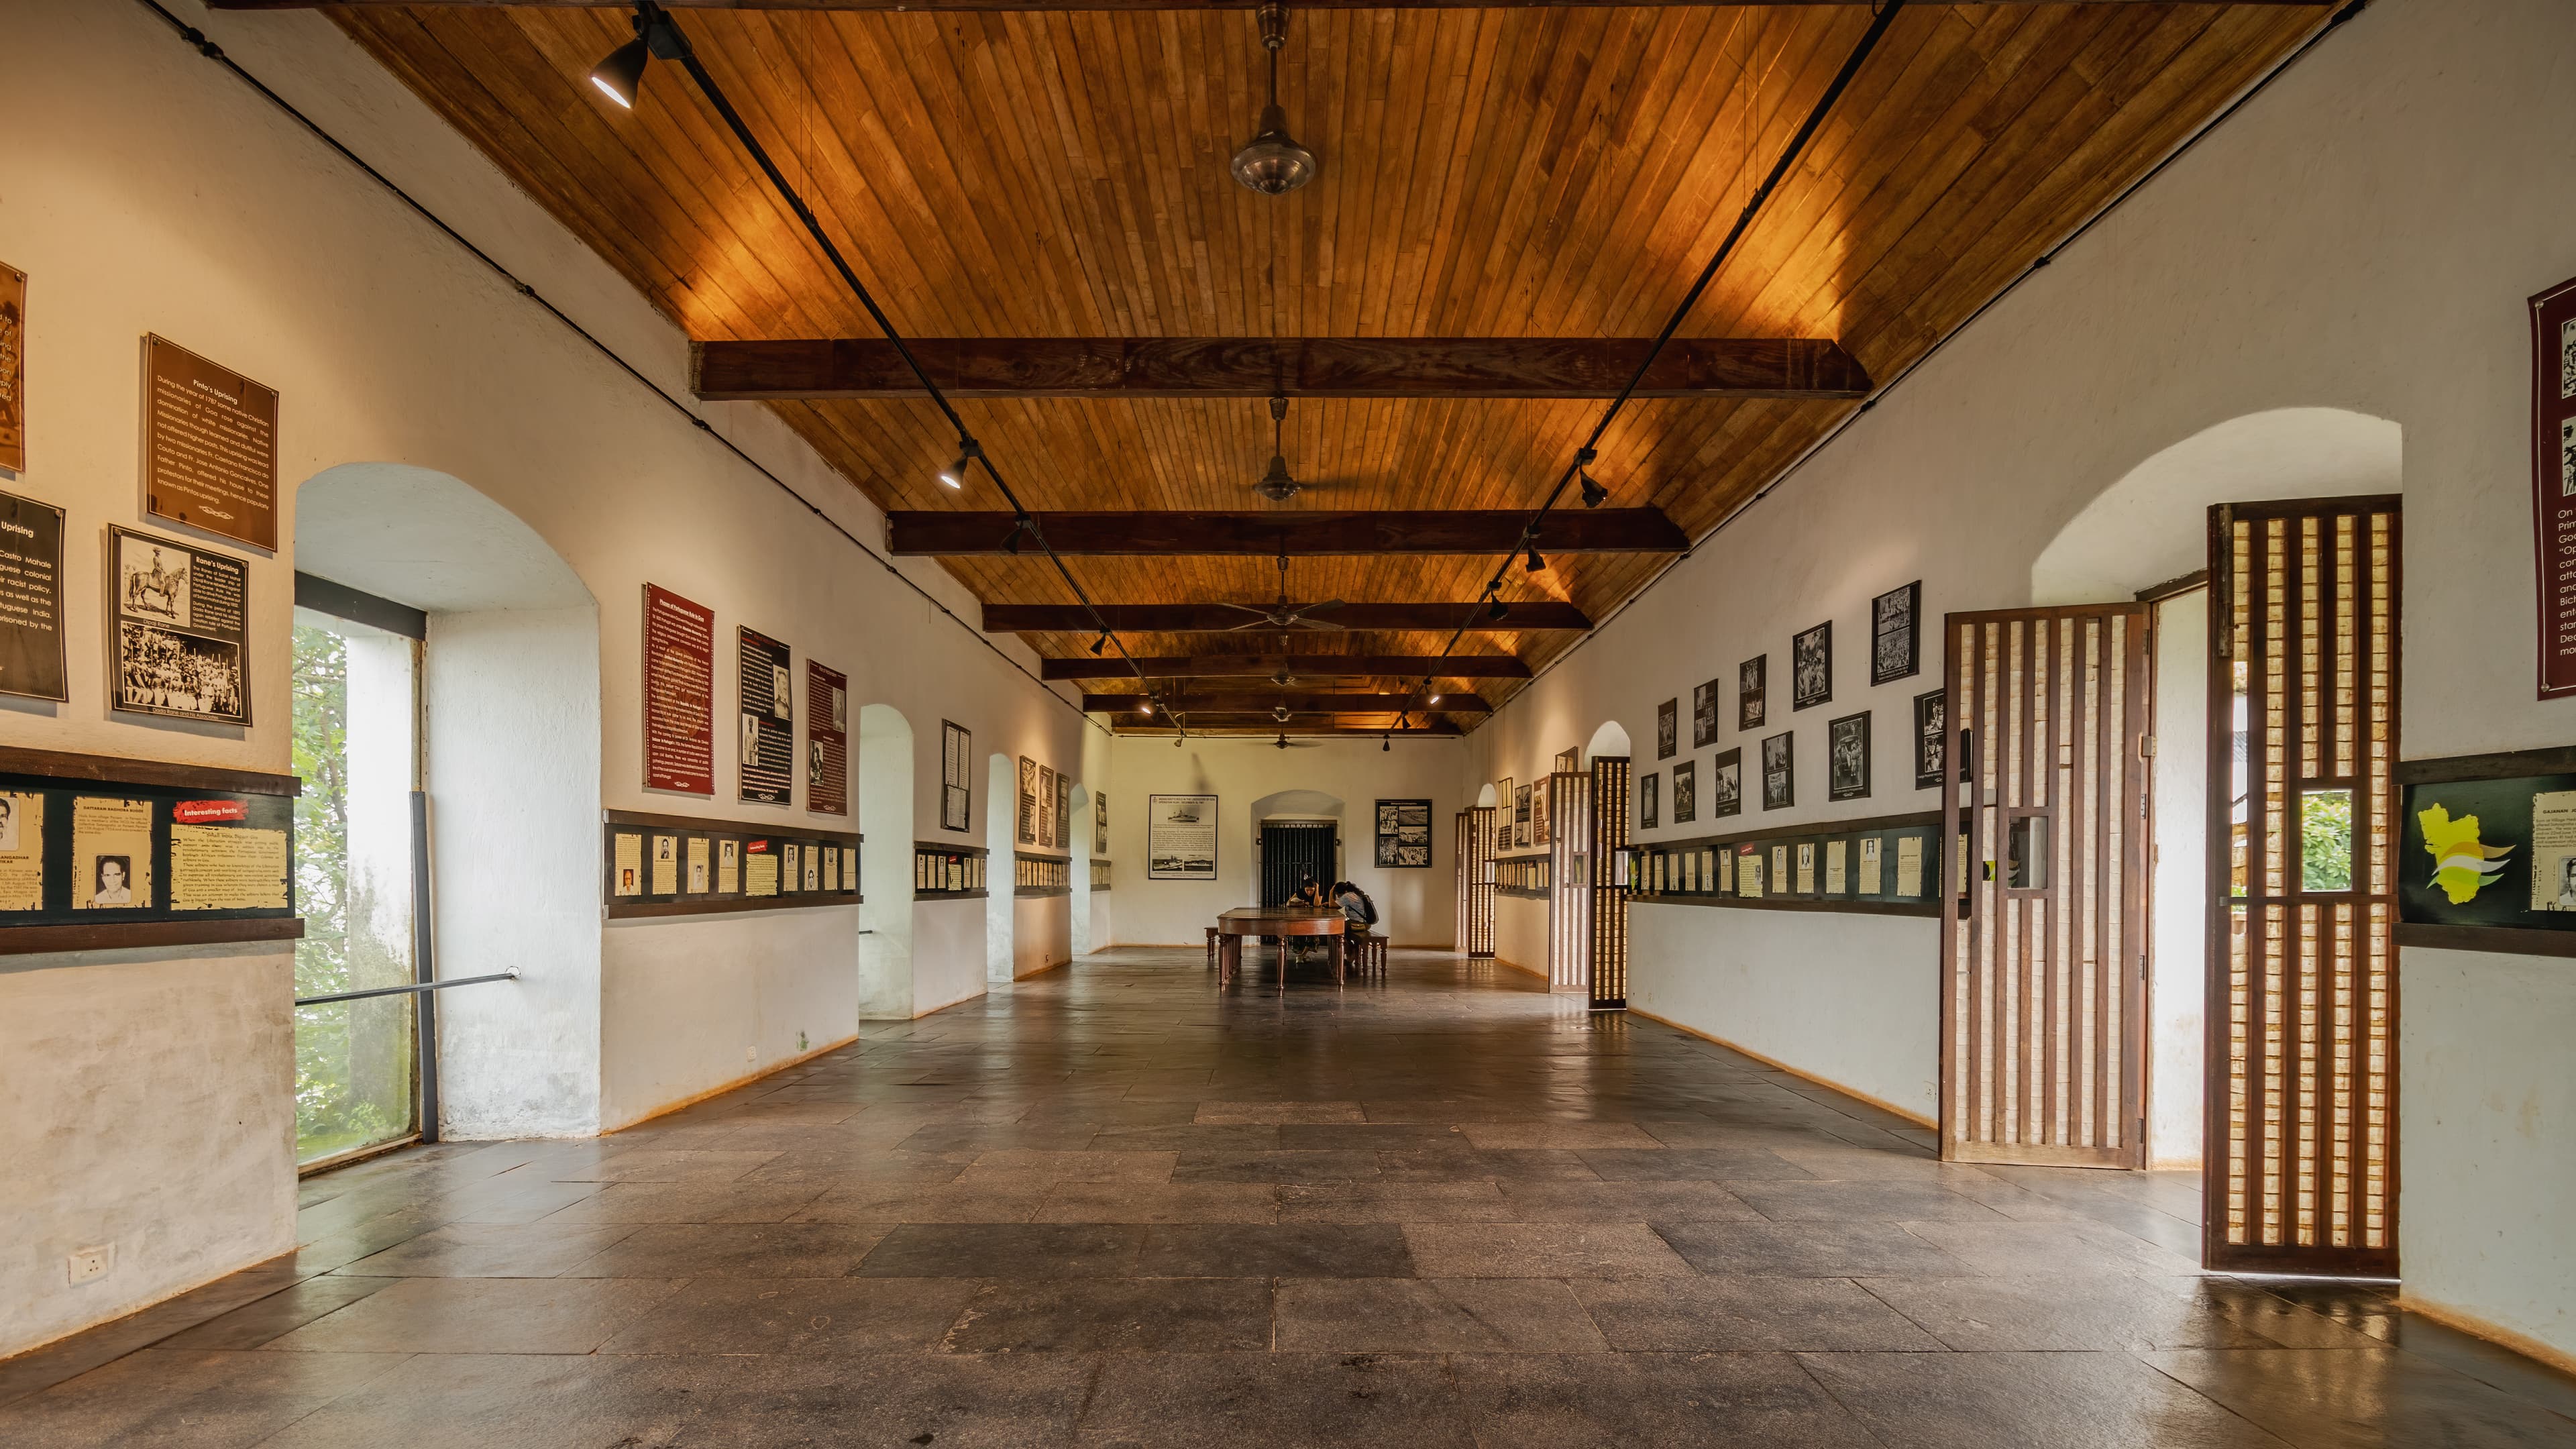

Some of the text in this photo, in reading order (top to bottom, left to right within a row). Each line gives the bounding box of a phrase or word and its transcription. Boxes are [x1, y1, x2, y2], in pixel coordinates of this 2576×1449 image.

[193, 379, 237, 405] Pinto's Uprising
[157, 375, 176, 388] During
[176, 383, 185, 392] the
[185, 388, 198, 397] year
[217, 402, 231, 412] some
[231, 408, 248, 419] native
[248, 414, 269, 427] Christian
[157, 398, 189, 415] domination
[157, 387, 191, 406] missionaries
[205, 407, 218, 417] Goa
[221, 415, 233, 423] rose
[237, 421, 256, 432] against
[260, 429, 269, 438] the
[157, 421, 167, 429] not
[157, 432, 165, 441] by
[165, 435, 176, 444] two
[189, 422, 209, 435] though
[229, 439, 240, 447] and
[157, 443, 176, 455] Couto
[176, 451, 188, 460] and
[209, 463, 229, 475] Antonio
[157, 455, 176, 466] Father
[197, 470, 217, 481] offered
[157, 477, 176, 489] known
[2558, 510, 2573, 519] On
[1, 521, 34, 538] Uprising
[25, 557, 52, 569] Mahale
[196, 556, 239, 575] Rane's Uprising
[24, 570, 52, 581] colonial
[7, 579, 26, 588] racist
[29, 584, 52, 594] policy.
[40, 598, 52, 606] the
[32, 608, 52, 619] India.
[2560, 608, 2576, 618] ent
[29, 621, 39, 629] by
[40, 623, 52, 631] the
